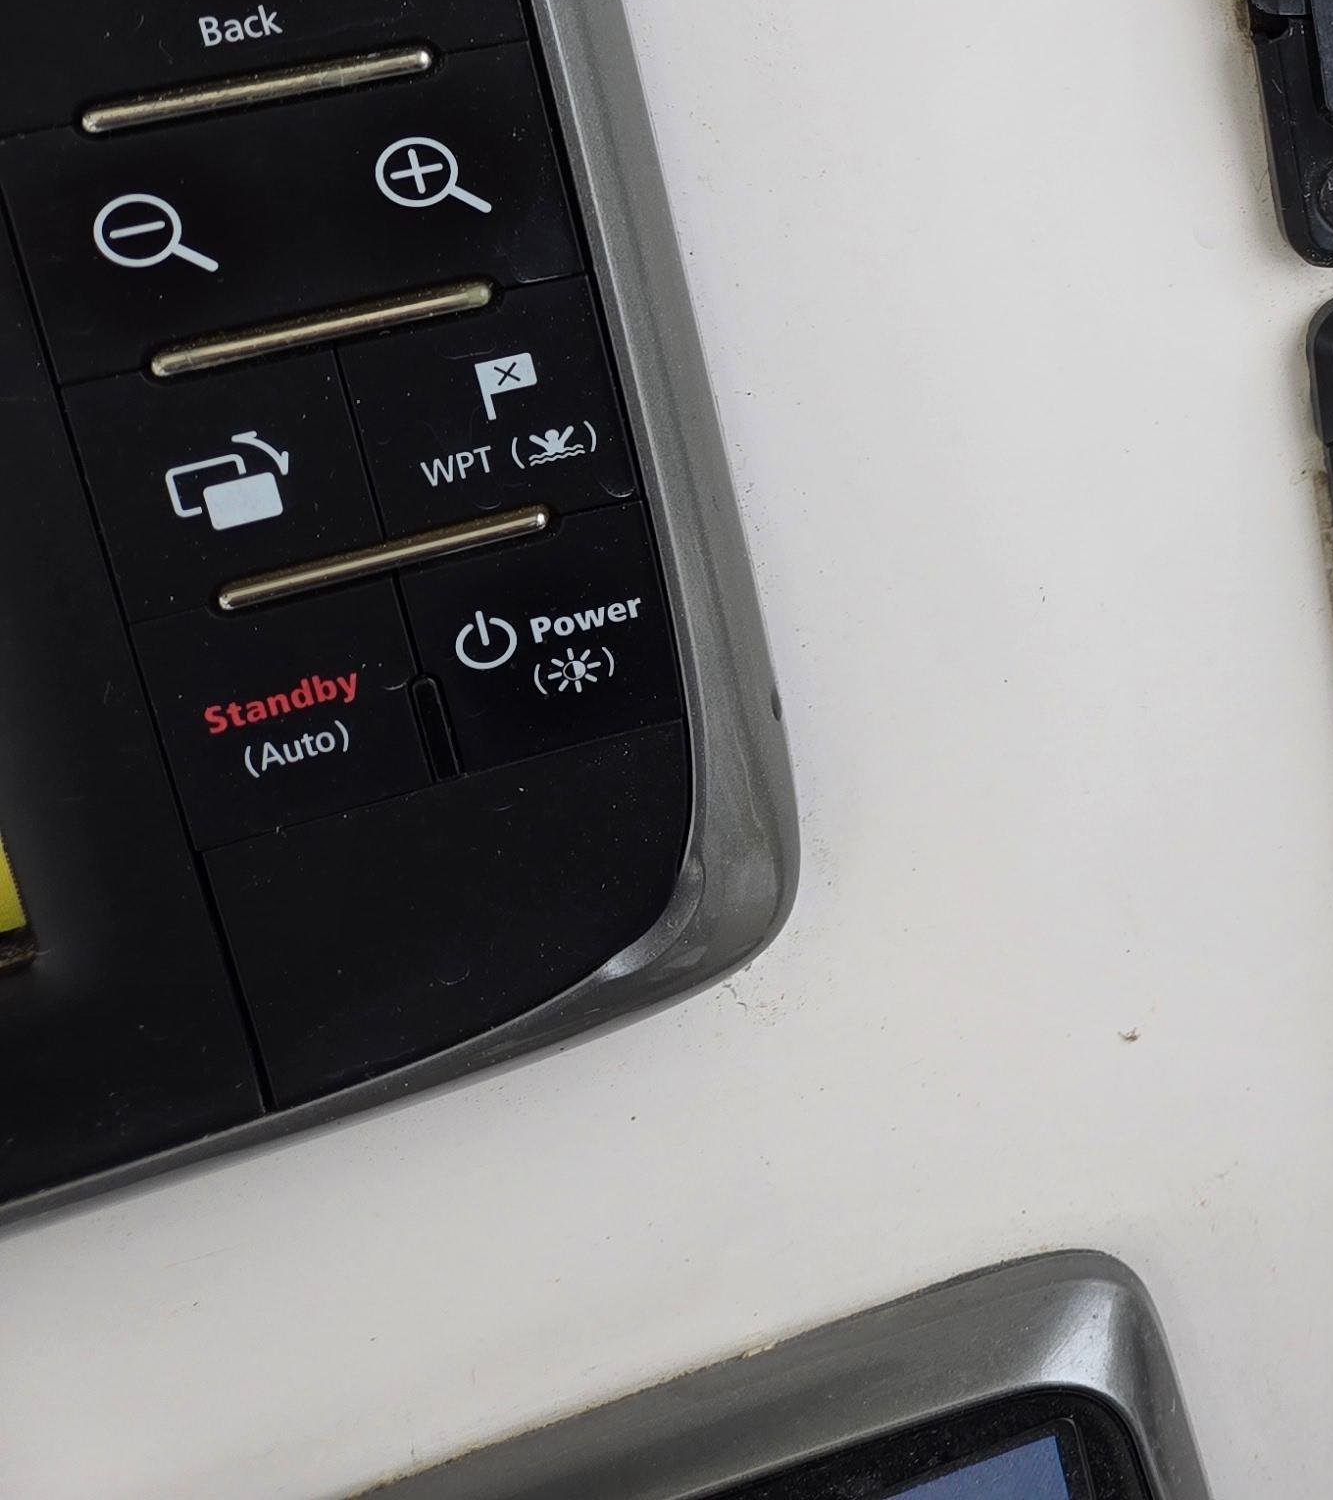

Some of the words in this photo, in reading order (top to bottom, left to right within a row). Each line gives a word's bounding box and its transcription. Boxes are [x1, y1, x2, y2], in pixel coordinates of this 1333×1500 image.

[200, 6, 282, 47] Back
[420, 447, 494, 486] WPT
[530, 595, 641, 644] Power
[204, 670, 359, 733] Standby
[244, 720, 350, 777] (Auto)
